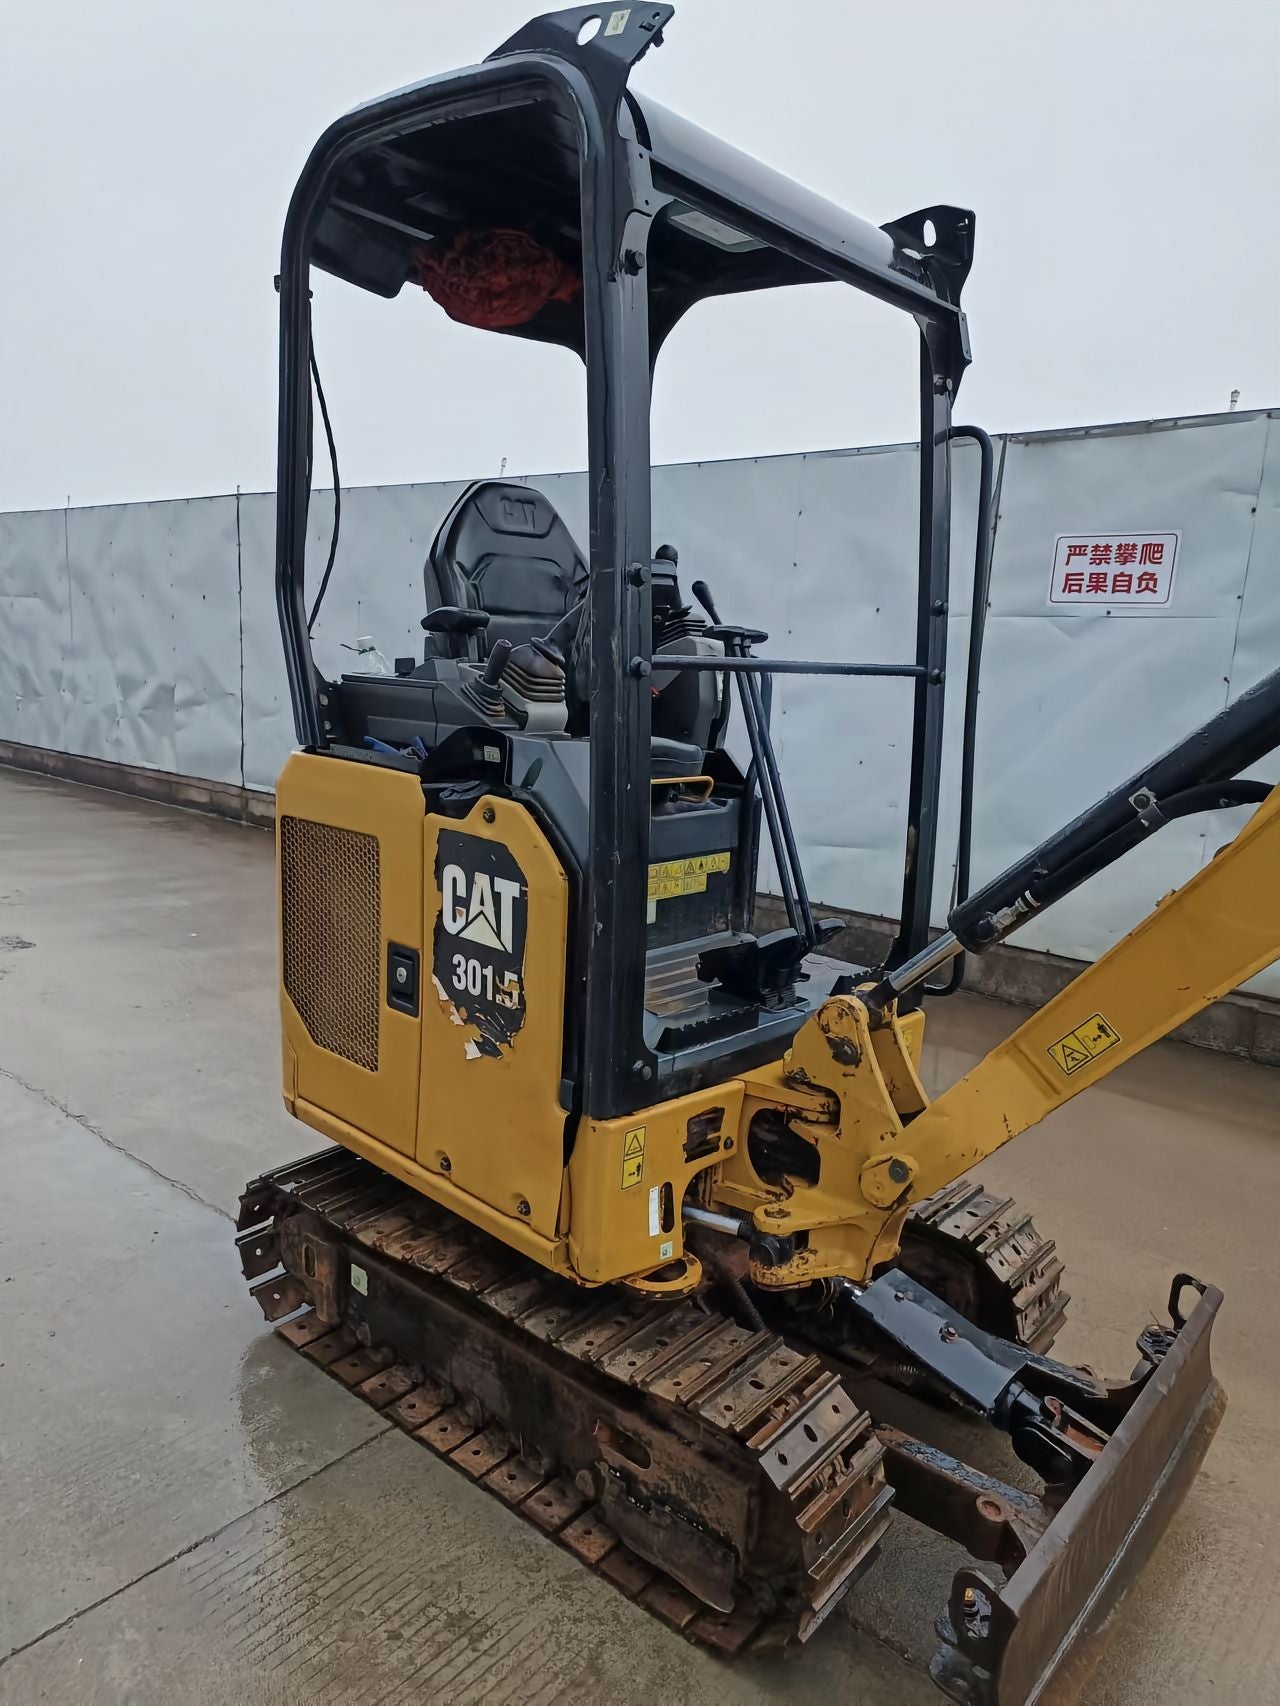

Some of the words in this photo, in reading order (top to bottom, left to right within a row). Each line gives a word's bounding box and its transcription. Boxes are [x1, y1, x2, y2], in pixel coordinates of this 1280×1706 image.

[1065, 543, 1164, 566] 严禁攀爬
[1062, 571, 1158, 594] 后果自负
[442, 864, 520, 954] CAT
